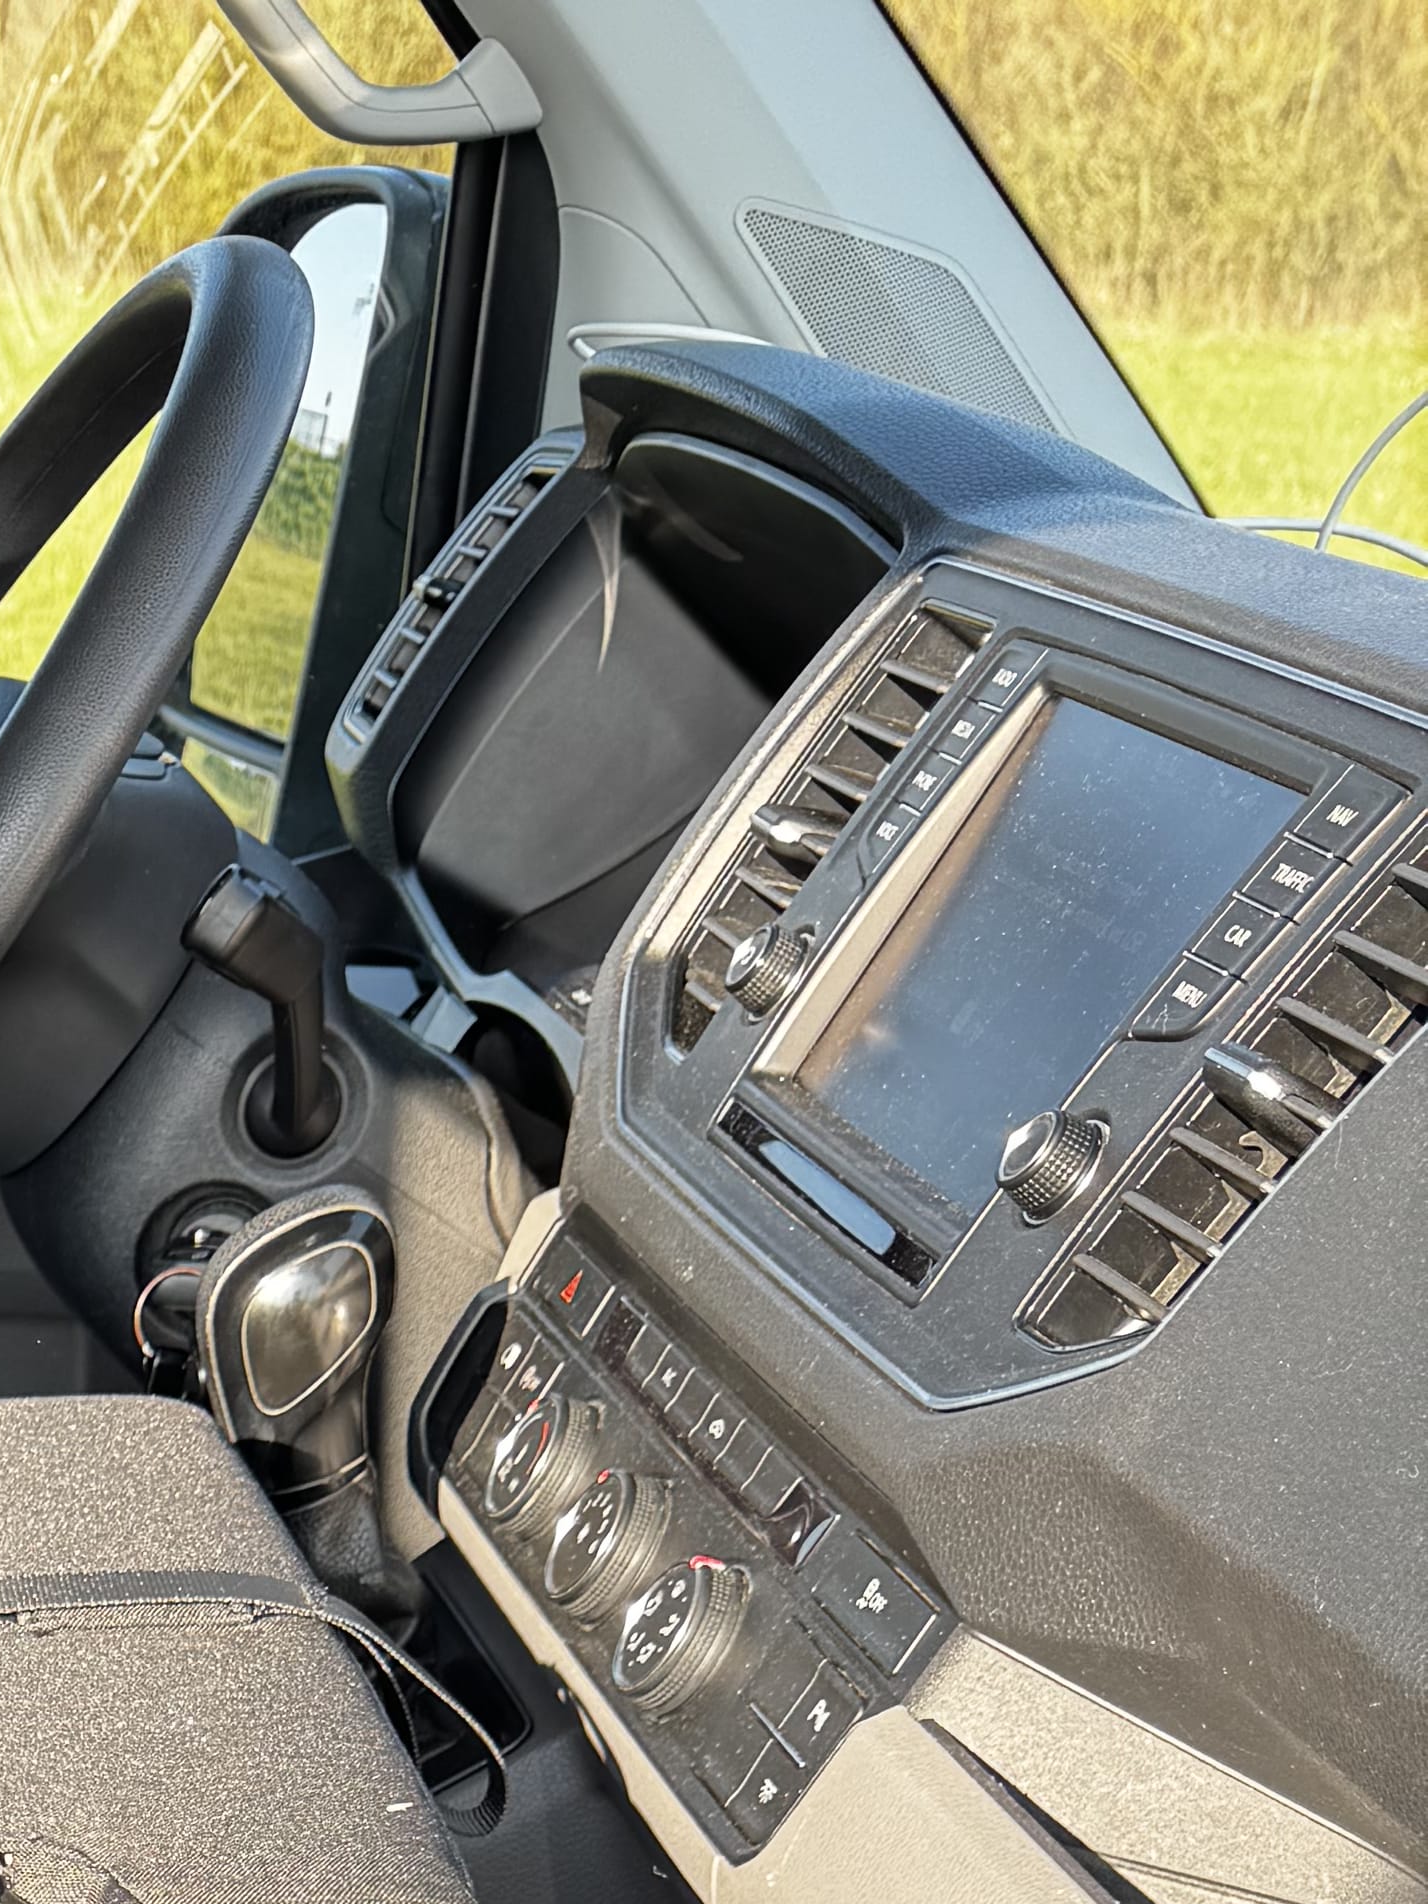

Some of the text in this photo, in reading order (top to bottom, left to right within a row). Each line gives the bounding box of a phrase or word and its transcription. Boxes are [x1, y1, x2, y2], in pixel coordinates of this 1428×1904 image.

[1326, 804, 1359, 827] NAV
[1271, 863, 1314, 893] TRAFFIC
[1224, 925, 1252, 948] CAR
[1172, 981, 1208, 1008] MENU
